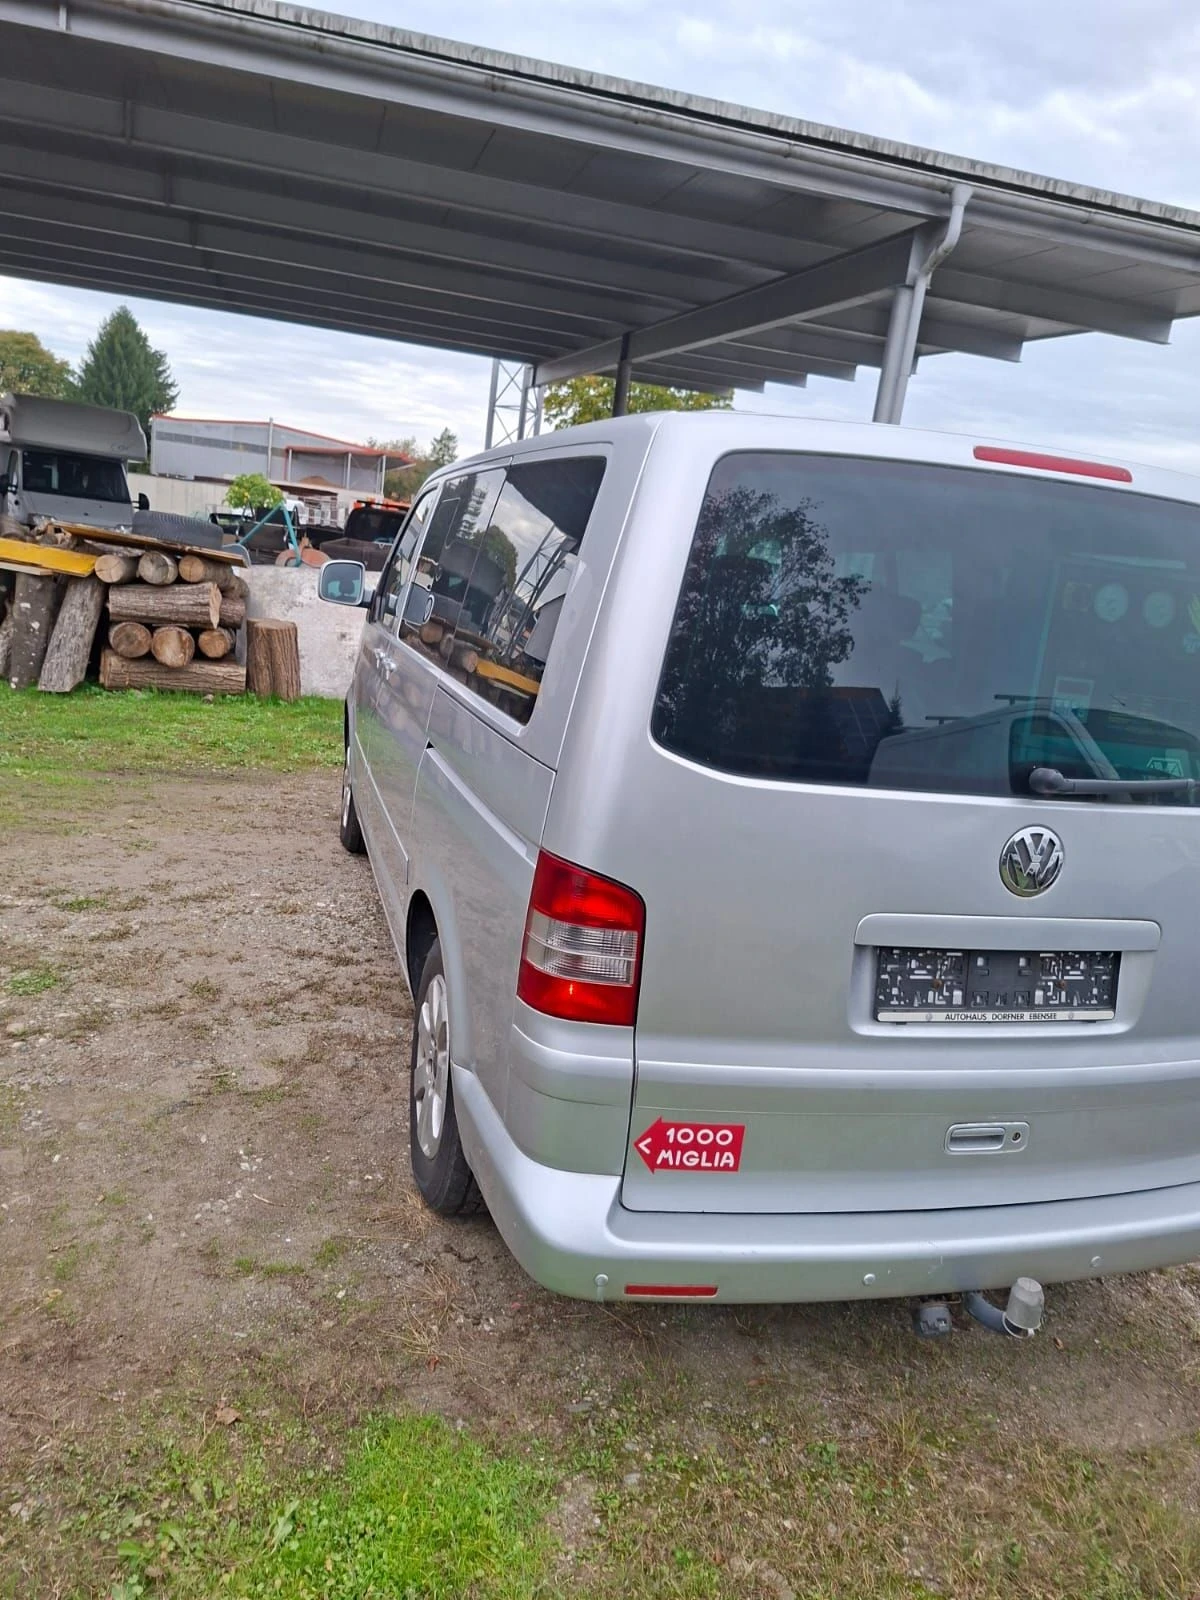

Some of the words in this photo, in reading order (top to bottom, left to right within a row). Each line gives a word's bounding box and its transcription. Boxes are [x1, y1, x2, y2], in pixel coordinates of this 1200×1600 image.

[1000, 825, 1064, 898] VW
[945, 1013, 987, 1021] AUTOHAUS
[1029, 1012, 1057, 1020] EBENSEE
[666, 1127, 734, 1146] 1000
[656, 1149, 735, 1168] MIGLIA
